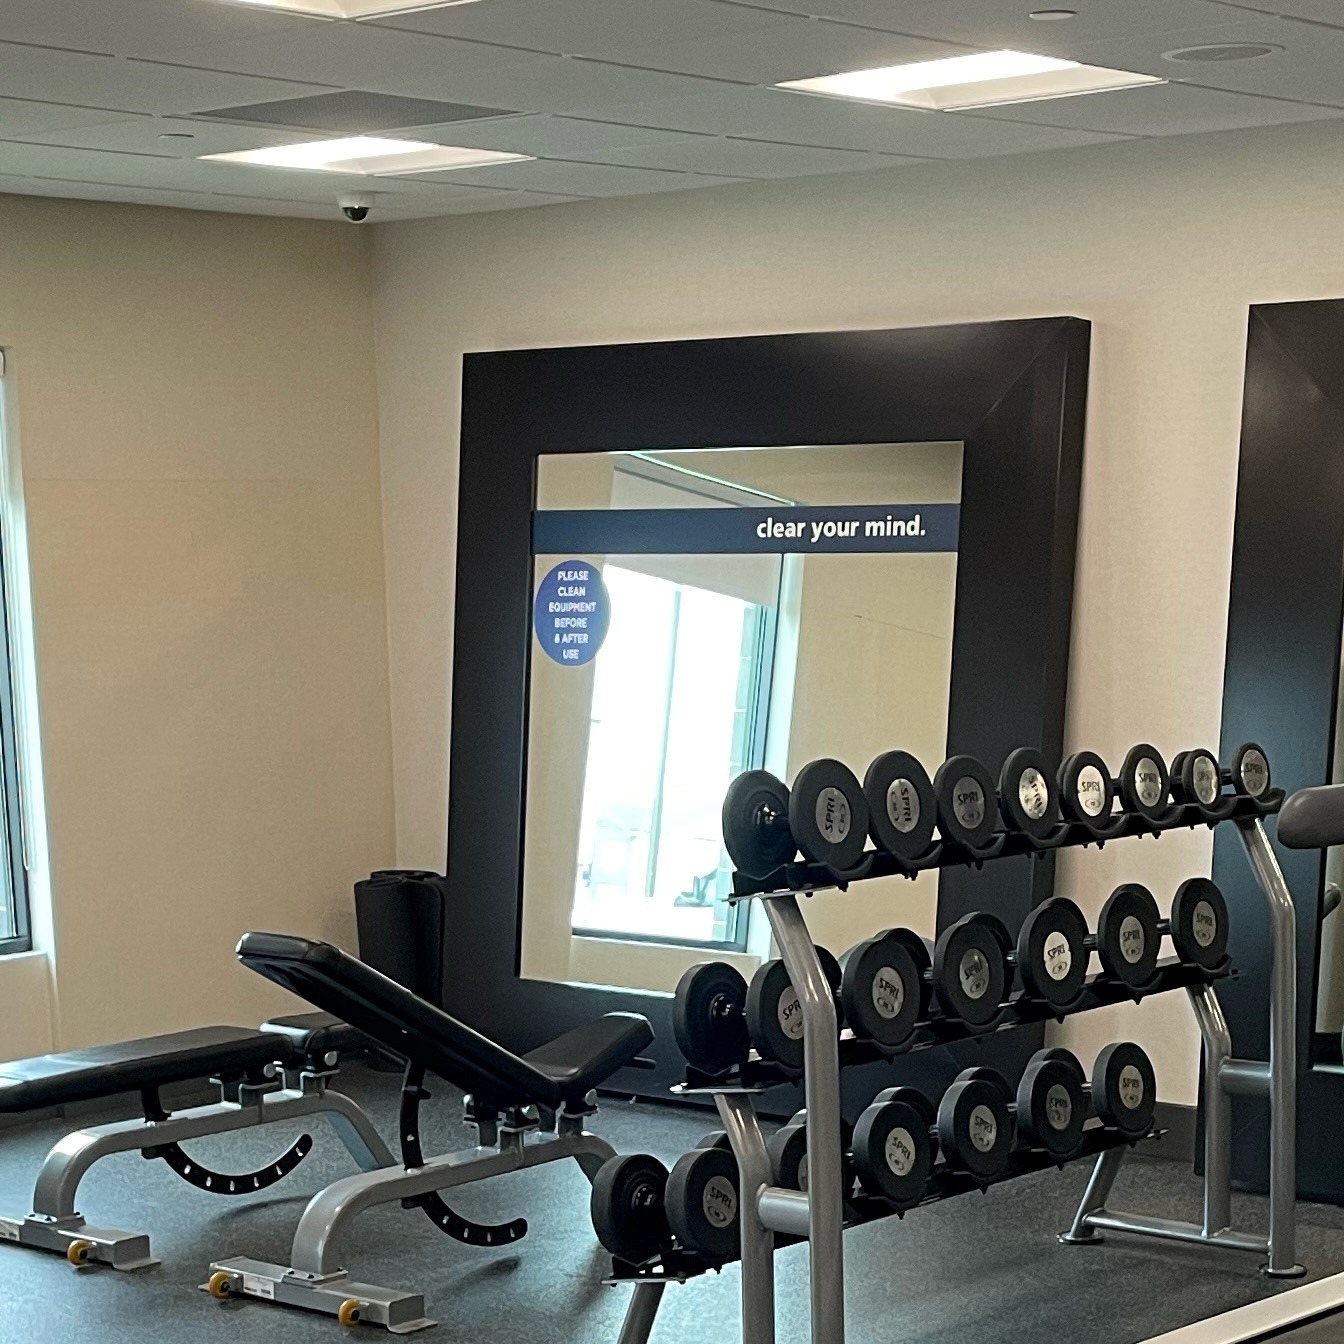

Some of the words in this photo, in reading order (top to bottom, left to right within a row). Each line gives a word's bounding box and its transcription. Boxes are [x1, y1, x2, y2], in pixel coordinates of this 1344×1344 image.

[756, 517, 806, 538] clear
[811, 520, 859, 543] your
[864, 514, 926, 537] mind.
[557, 570, 589, 581] PLEASE
[557, 586, 586, 597] CLEAN
[548, 601, 597, 613] EQUIPMENT
[554, 617, 588, 628] BEFORE
[561, 633, 589, 644] AFTER
[562, 649, 580, 660] USE
[878, 977, 900, 1000] SPRI
[782, 1000, 802, 1020] SPR
[708, 1186, 732, 1208] SPRI
